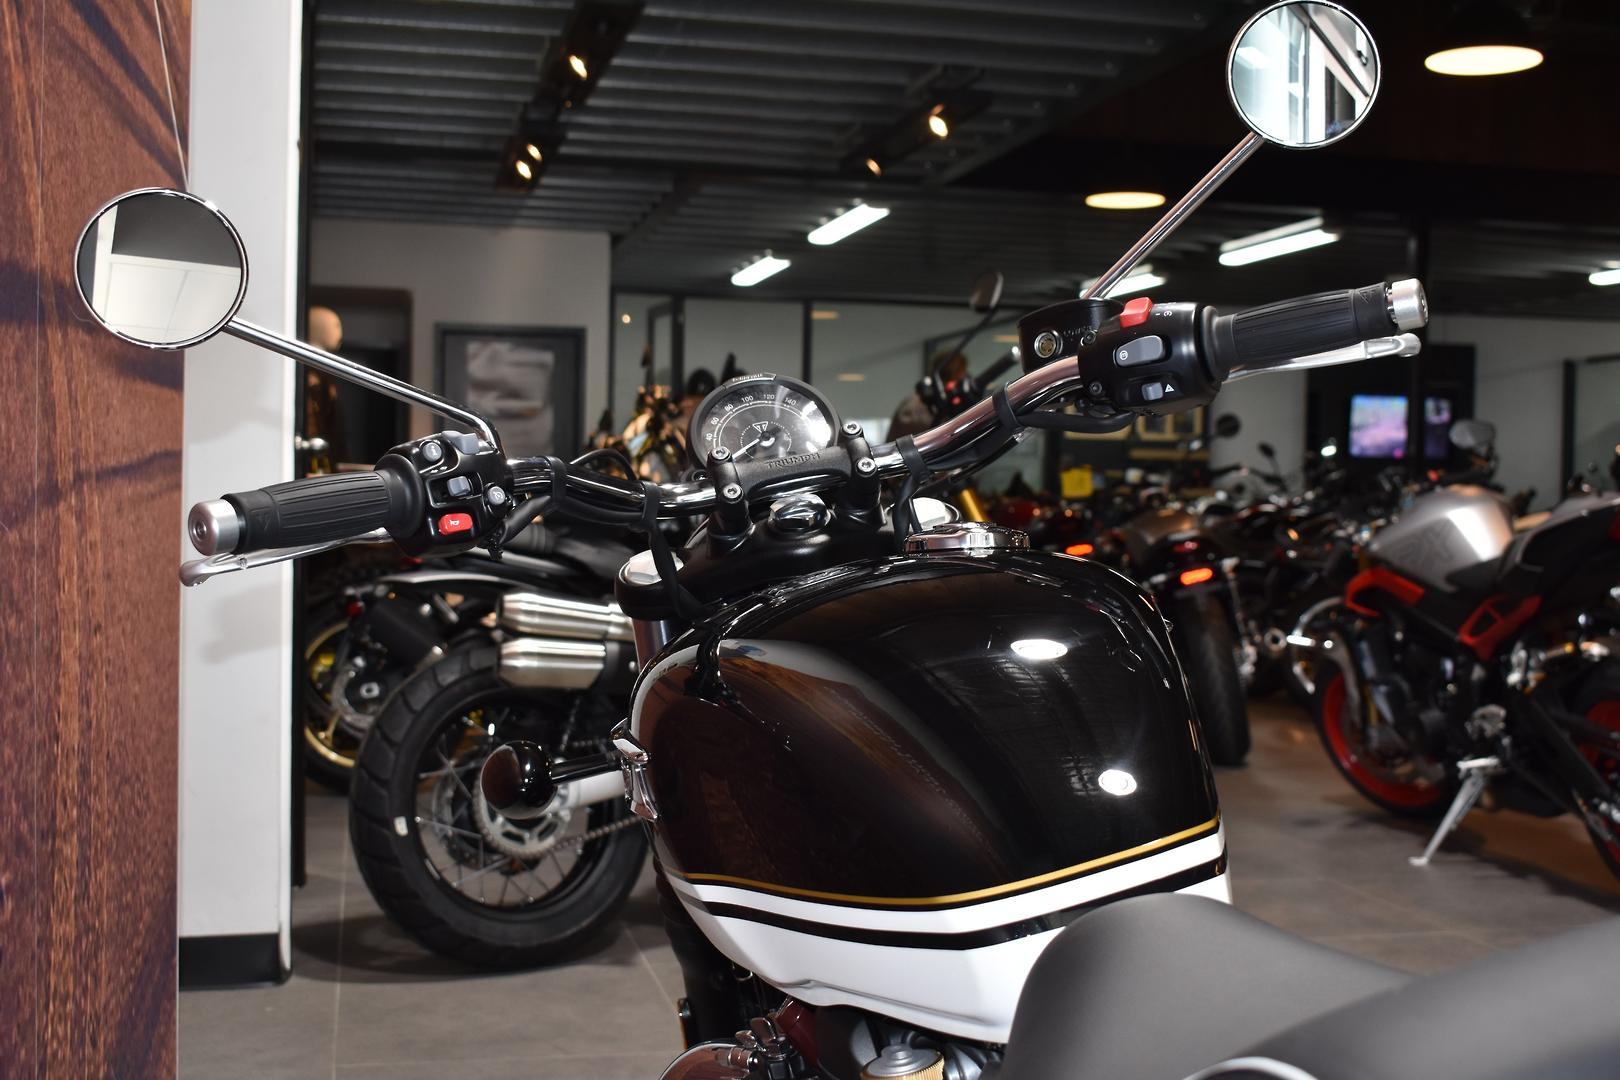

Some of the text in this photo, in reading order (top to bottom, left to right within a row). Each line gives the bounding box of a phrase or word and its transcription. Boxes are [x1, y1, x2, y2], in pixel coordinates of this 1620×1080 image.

[741, 395, 754, 403] 100
[784, 397, 797, 406] 140
[706, 433, 713, 441] 40
[767, 453, 821, 469] TRIUMPH
